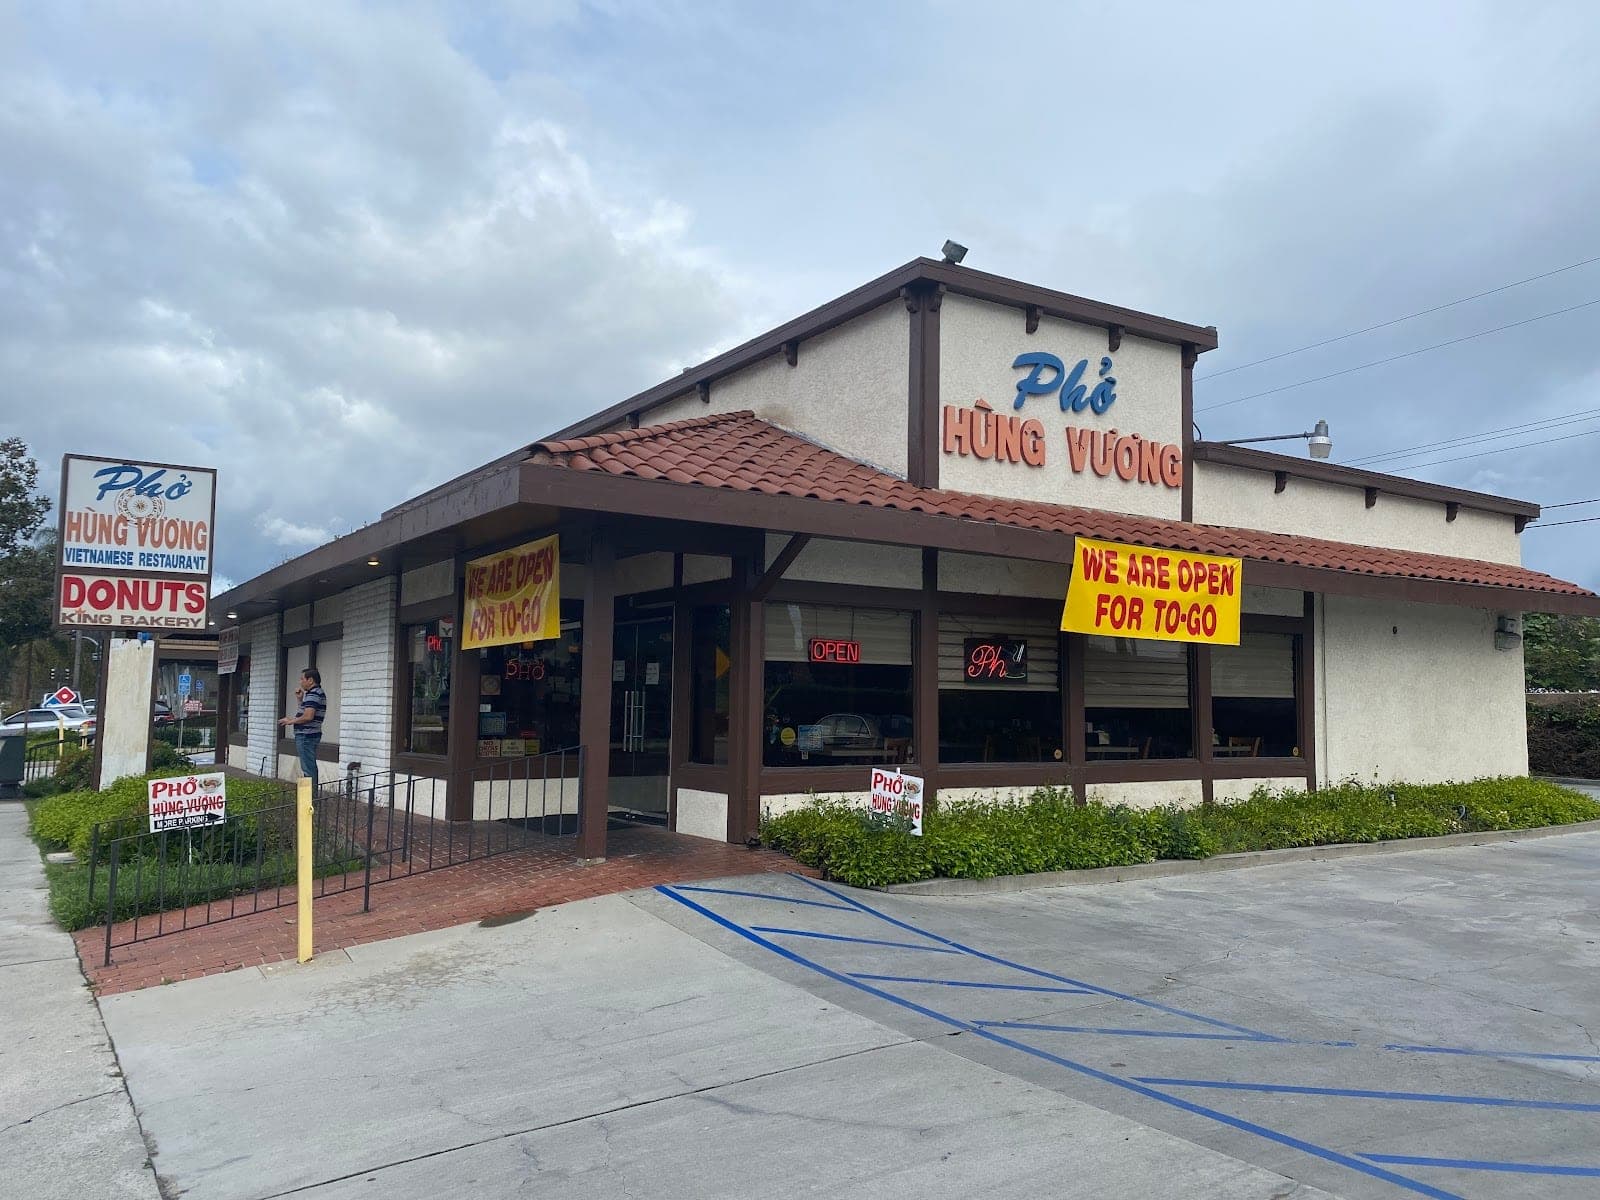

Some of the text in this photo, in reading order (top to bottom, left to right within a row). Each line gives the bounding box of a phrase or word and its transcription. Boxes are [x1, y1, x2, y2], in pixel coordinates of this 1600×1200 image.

[1011, 351, 1117, 415] Phở
[943, 398, 1183, 488] HÙNG VƯƠNG
[93, 464, 193, 501] Phở
[66, 507, 207, 551] HÙNG VƯƠNG
[64, 547, 206, 571] VIETNAMESE RESTAURANT
[468, 544, 554, 600] WE ARE OPEN
[1082, 547, 1235, 597] WE ARE OPEN
[62, 576, 205, 614] DONUTS
[1094, 593, 1217, 637] FOR TO-GO
[61, 611, 202, 628] KING BAKERY
[470, 606, 495, 641] FOR
[812, 642, 858, 662] OPEN
